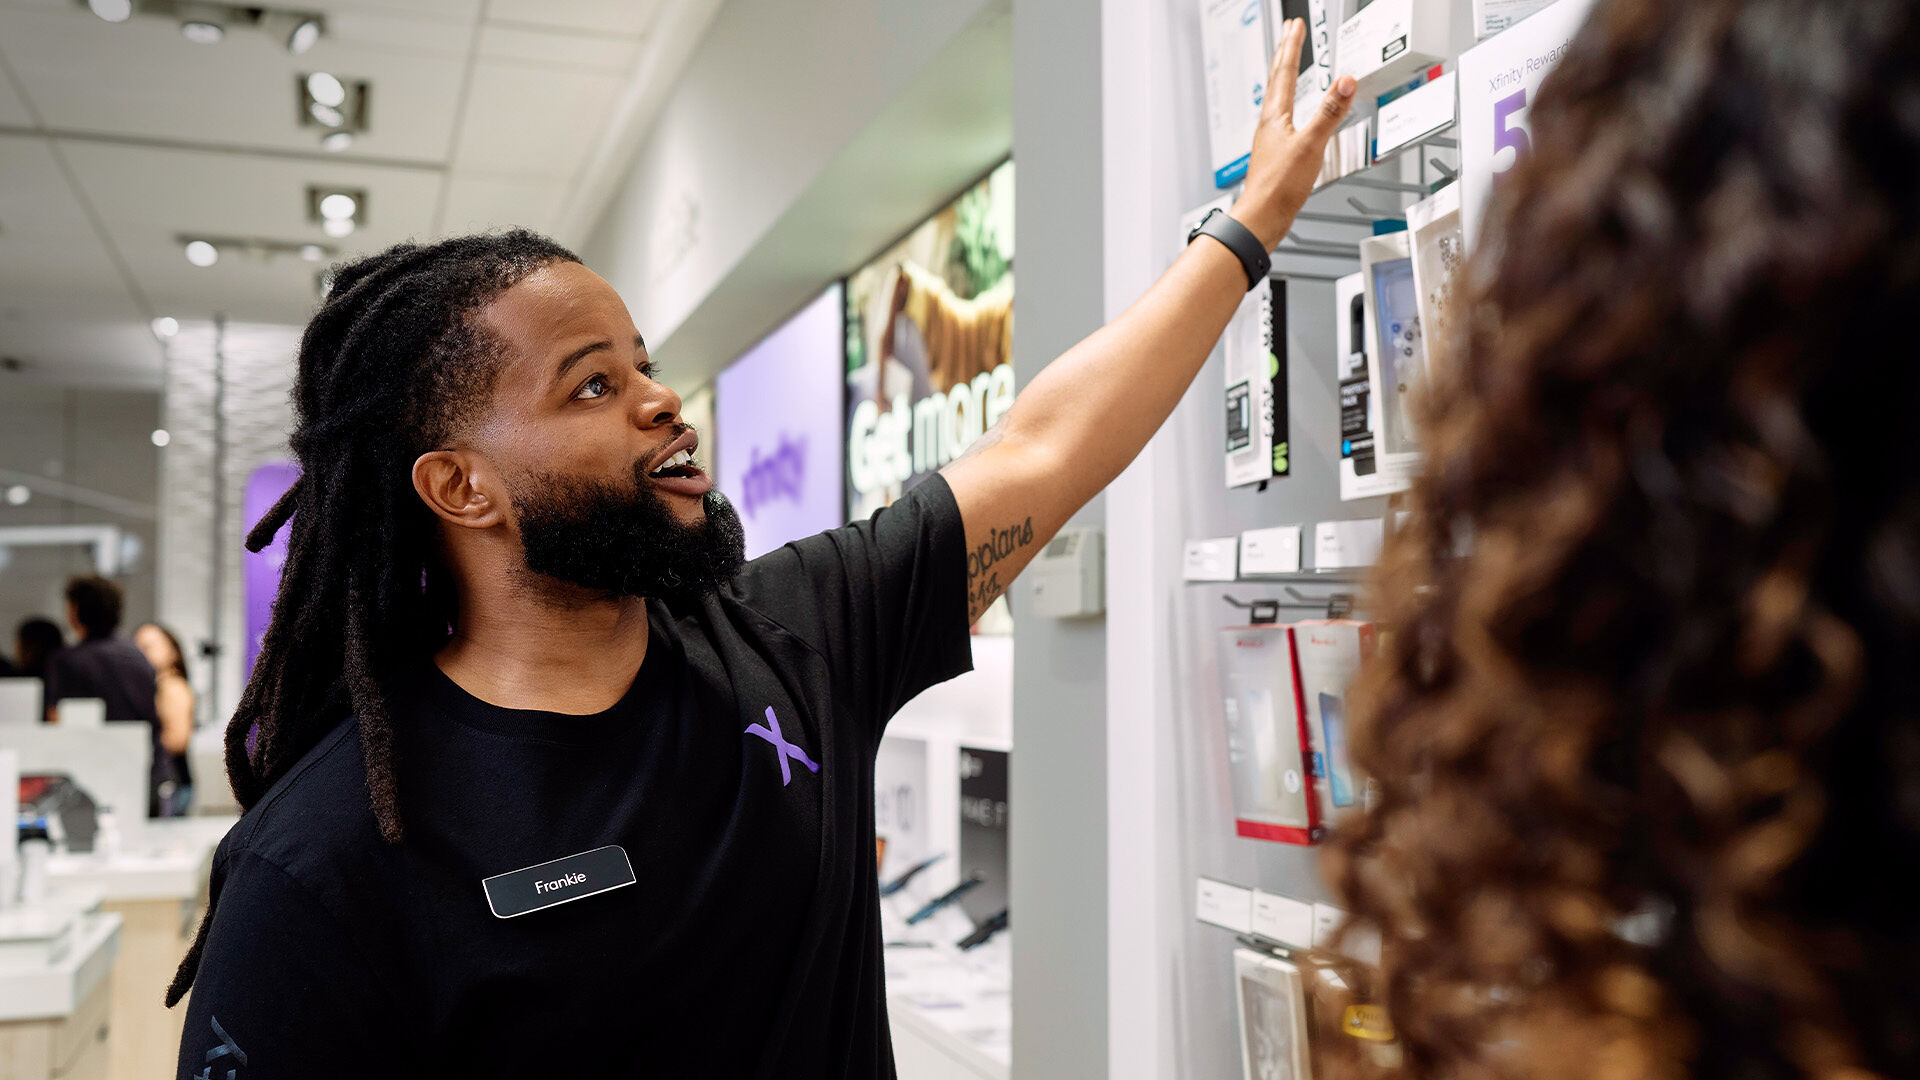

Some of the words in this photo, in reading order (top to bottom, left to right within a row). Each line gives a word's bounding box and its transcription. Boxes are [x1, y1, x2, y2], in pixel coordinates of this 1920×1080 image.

[1488, 65, 1525, 93] Xfinity
[849, 396, 913, 494] Get
[912, 363, 1016, 475] more
[534, 871, 587, 895] Frankie
